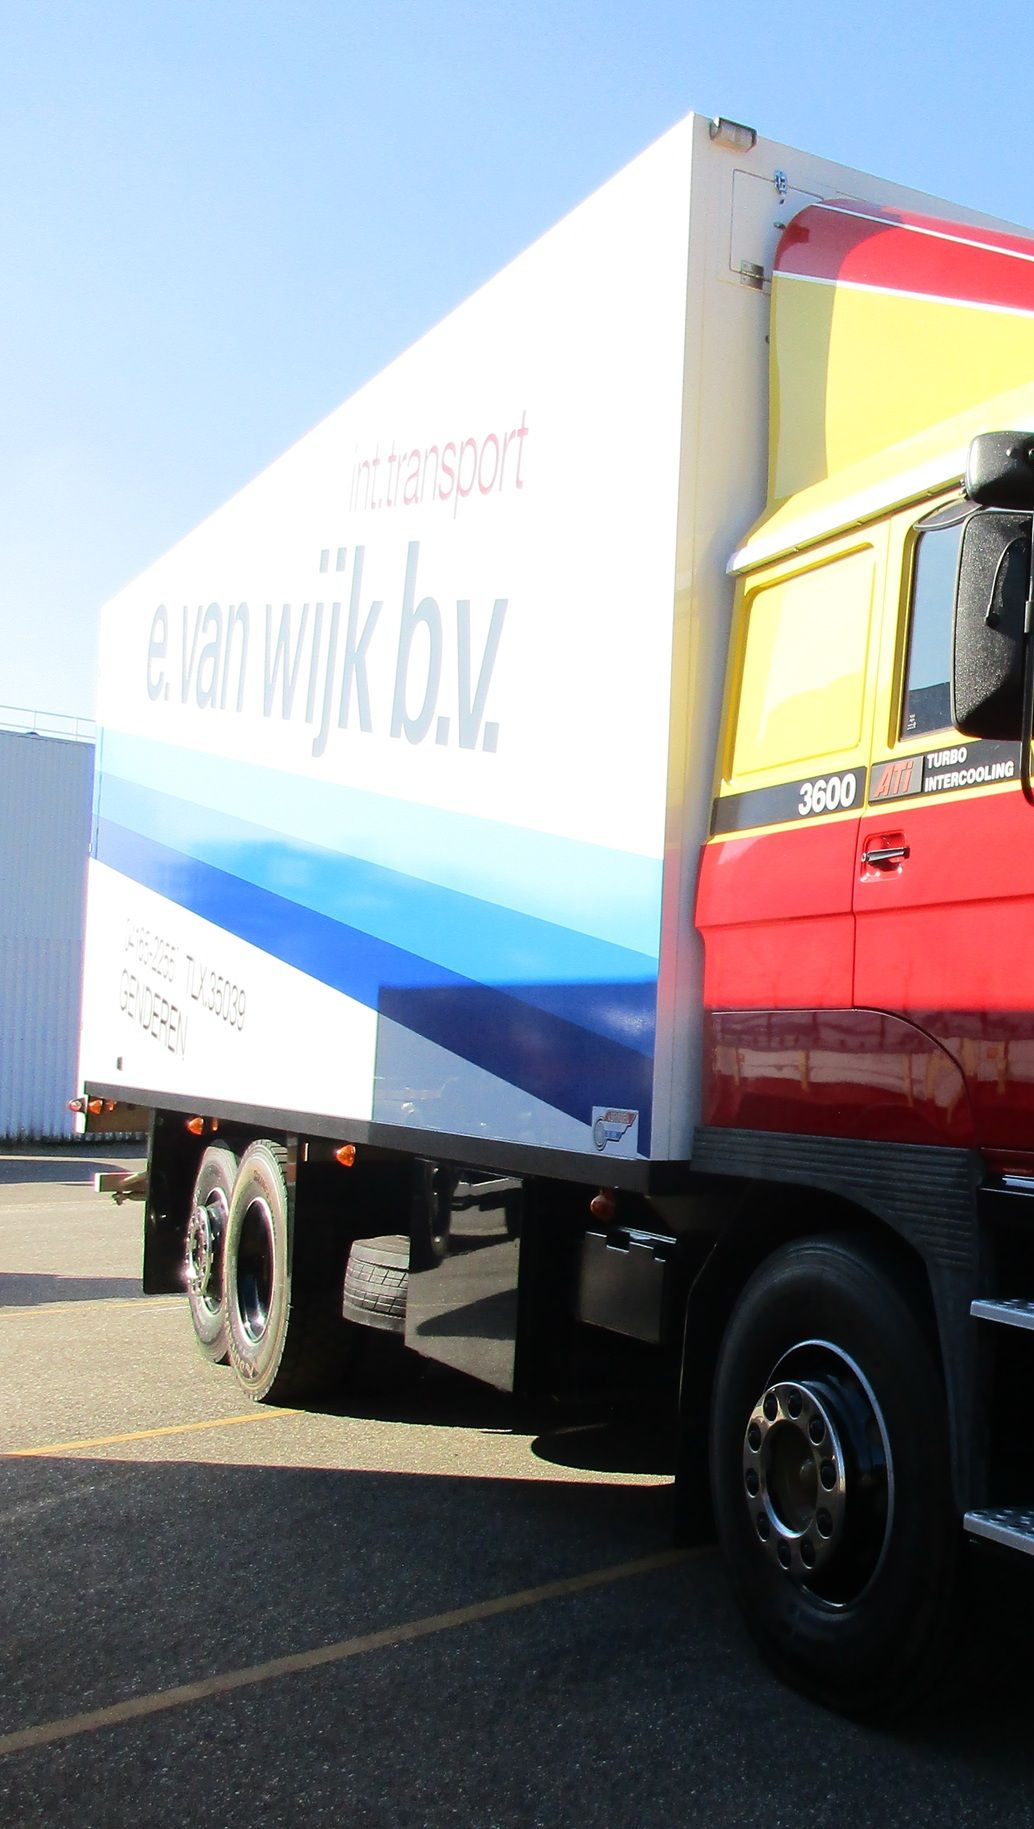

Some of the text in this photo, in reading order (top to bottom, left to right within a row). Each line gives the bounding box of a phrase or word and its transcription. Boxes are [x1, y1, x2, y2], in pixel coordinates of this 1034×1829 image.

[182, 600, 250, 712] van
[262, 545, 384, 758] wijk
[390, 540, 509, 753] b.v.
[798, 773, 857, 816] 3600
[924, 761, 1015, 793] INTERCOOLING
[926, 747, 968, 770] TURBO
[120, 969, 188, 1059] GENDEREN
